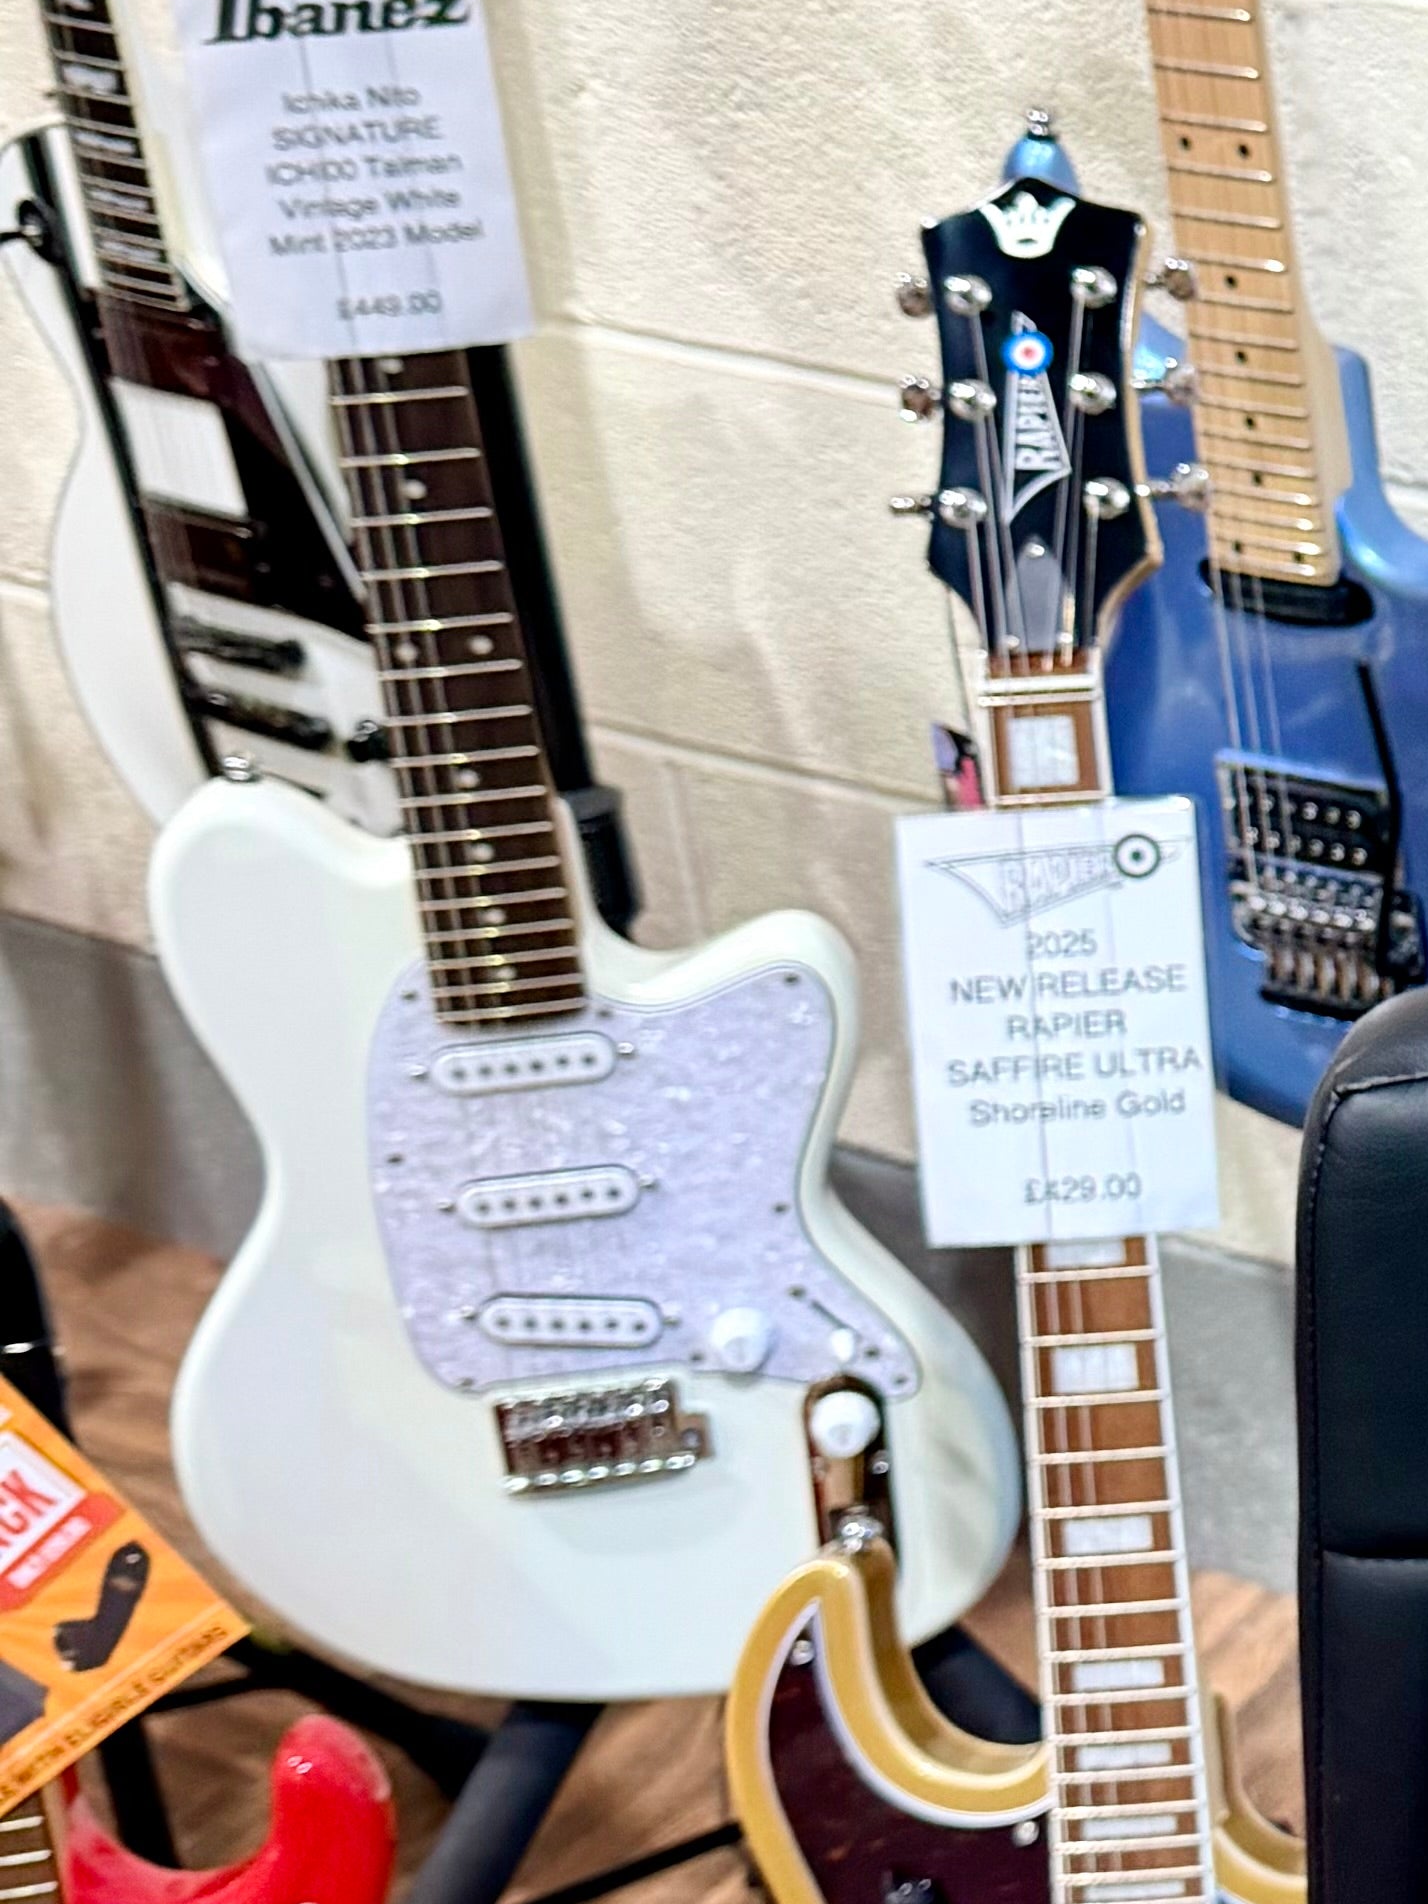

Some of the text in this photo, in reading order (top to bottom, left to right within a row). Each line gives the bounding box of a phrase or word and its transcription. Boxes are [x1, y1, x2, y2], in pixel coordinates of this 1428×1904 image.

[271, 116, 443, 151] SIGNATURE
[268, 230, 328, 256] Mint
[404, 219, 485, 248] Model
[1026, 928, 1098, 959] 2025
[950, 963, 1188, 1004] NEW RELEASE
[1006, 1009, 1128, 1041] RAPIER
[947, 1046, 1204, 1088] SAFFIRE ULTRA
[970, 1089, 1186, 1129] Shoreline Gold
[1024, 1172, 1142, 1205] £429.00
